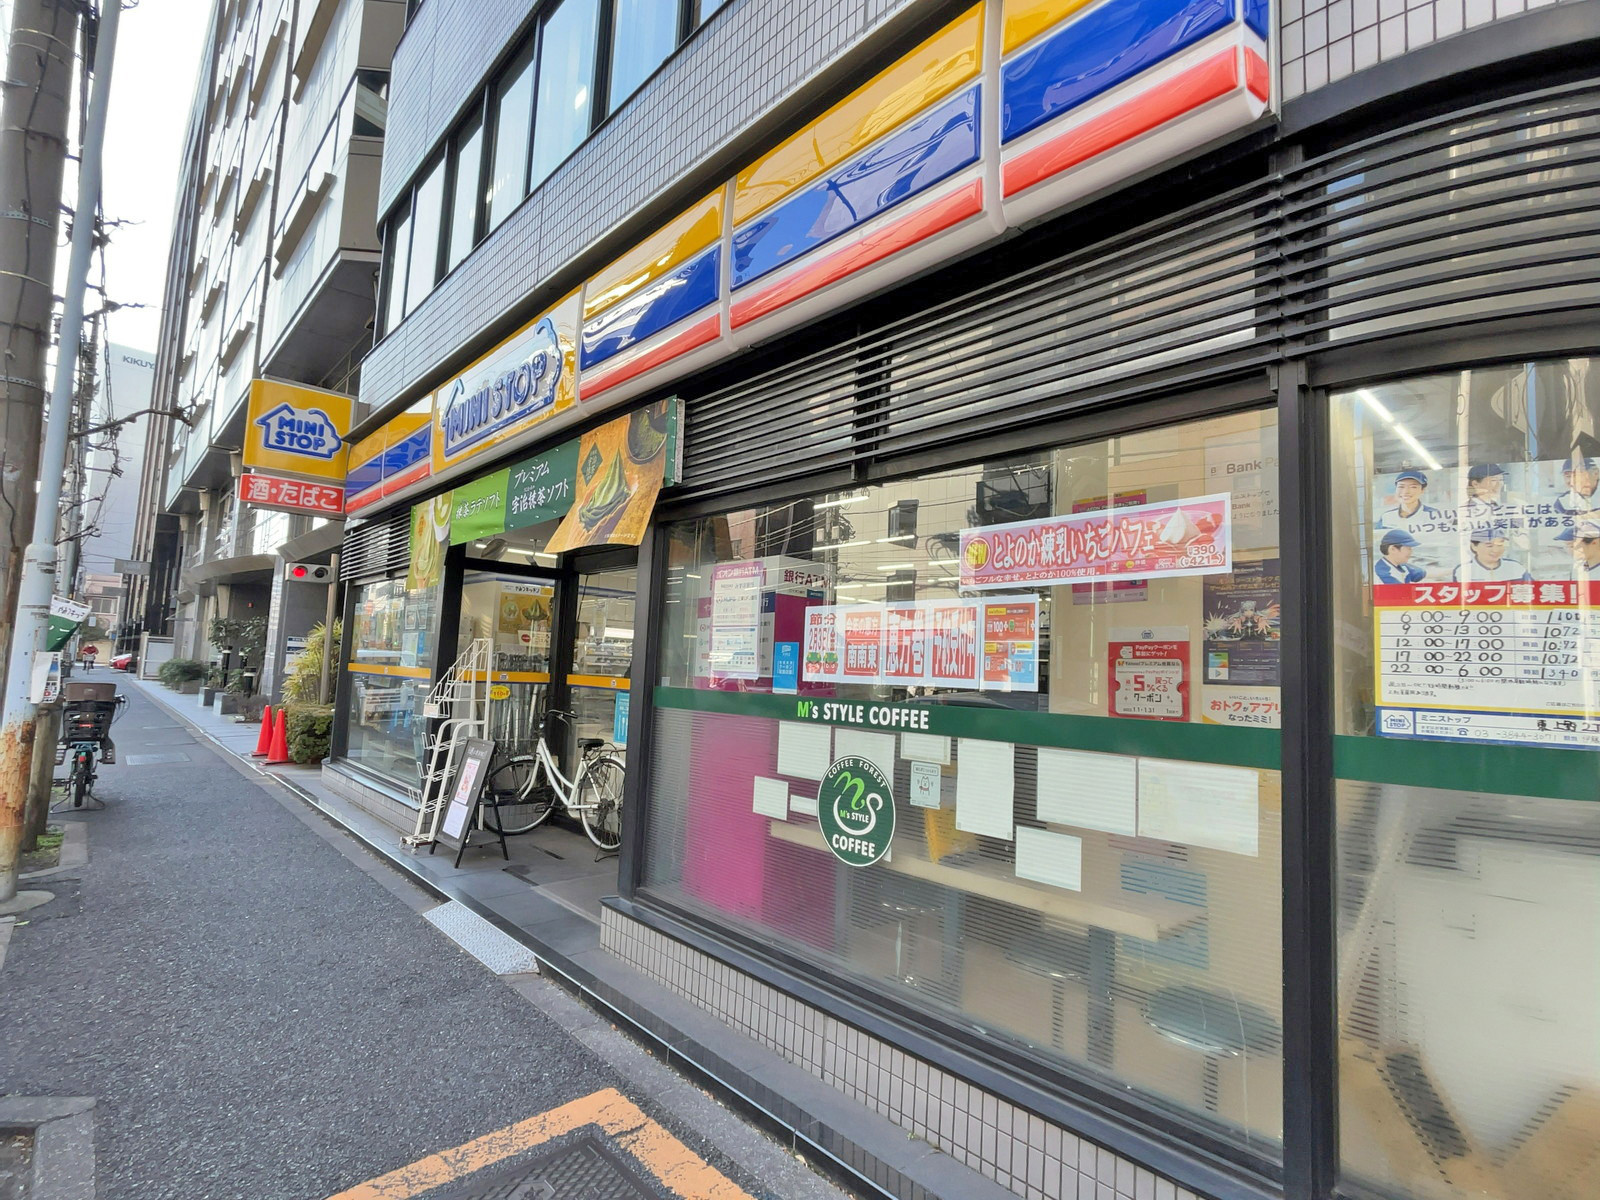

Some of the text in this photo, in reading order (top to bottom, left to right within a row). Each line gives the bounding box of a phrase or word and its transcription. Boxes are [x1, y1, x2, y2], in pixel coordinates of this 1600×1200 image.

[448, 350, 548, 441] MINI STOP
[277, 415, 325, 438] MINI
[274, 430, 326, 451] STOP
[514, 460, 550, 490] プレミアム
[1226, 460, 1263, 475] Bank
[247, 477, 338, 510] 酒・たばこ
[455, 491, 501, 520] 抹茶ラテソフト
[511, 478, 569, 515] 宇治抹茶ソフト
[992, 518, 1156, 569] とよのか練乳いちごパフェ
[1414, 583, 1578, 605] スタッフ募集!
[809, 612, 838, 626] 節分
[887, 609, 924, 675] 恵方巻
[934, 607, 976, 677] 予約受付中
[847, 643, 878, 669] 南南東
[1133, 692, 1162, 703] クーポン
[1156, 684, 1169, 692] くる
[797, 700, 930, 730] M's STYLE COFFEE
[1228, 713, 1272, 724] なったミミ!
[1420, 714, 1472, 724] ミニストップ
[827, 758, 887, 788] COFFEE FOREST
[839, 809, 870, 824] M's STYLE
[831, 833, 876, 858] COFFEE
